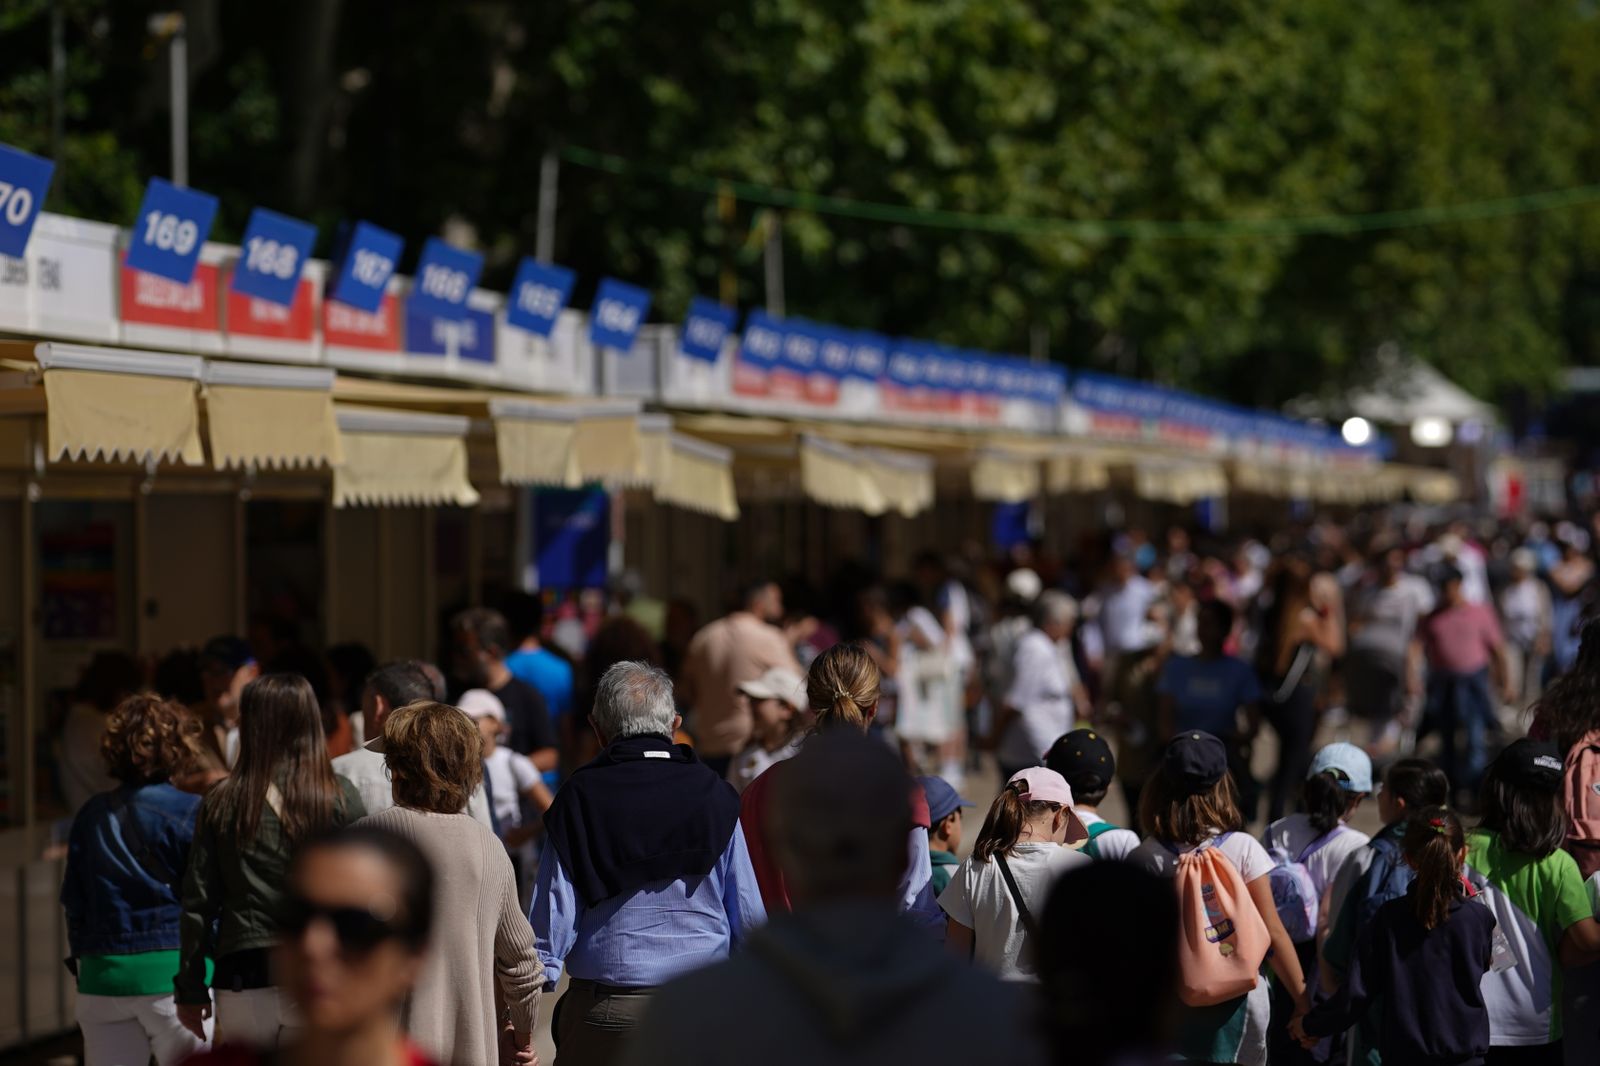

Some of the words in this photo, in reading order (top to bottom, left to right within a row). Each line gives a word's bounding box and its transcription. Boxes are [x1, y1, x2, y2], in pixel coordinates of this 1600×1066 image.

[0, 181, 33, 227] 70
[144, 209, 199, 256] 169
[246, 235, 300, 280] 168
[351, 248, 394, 289] 167
